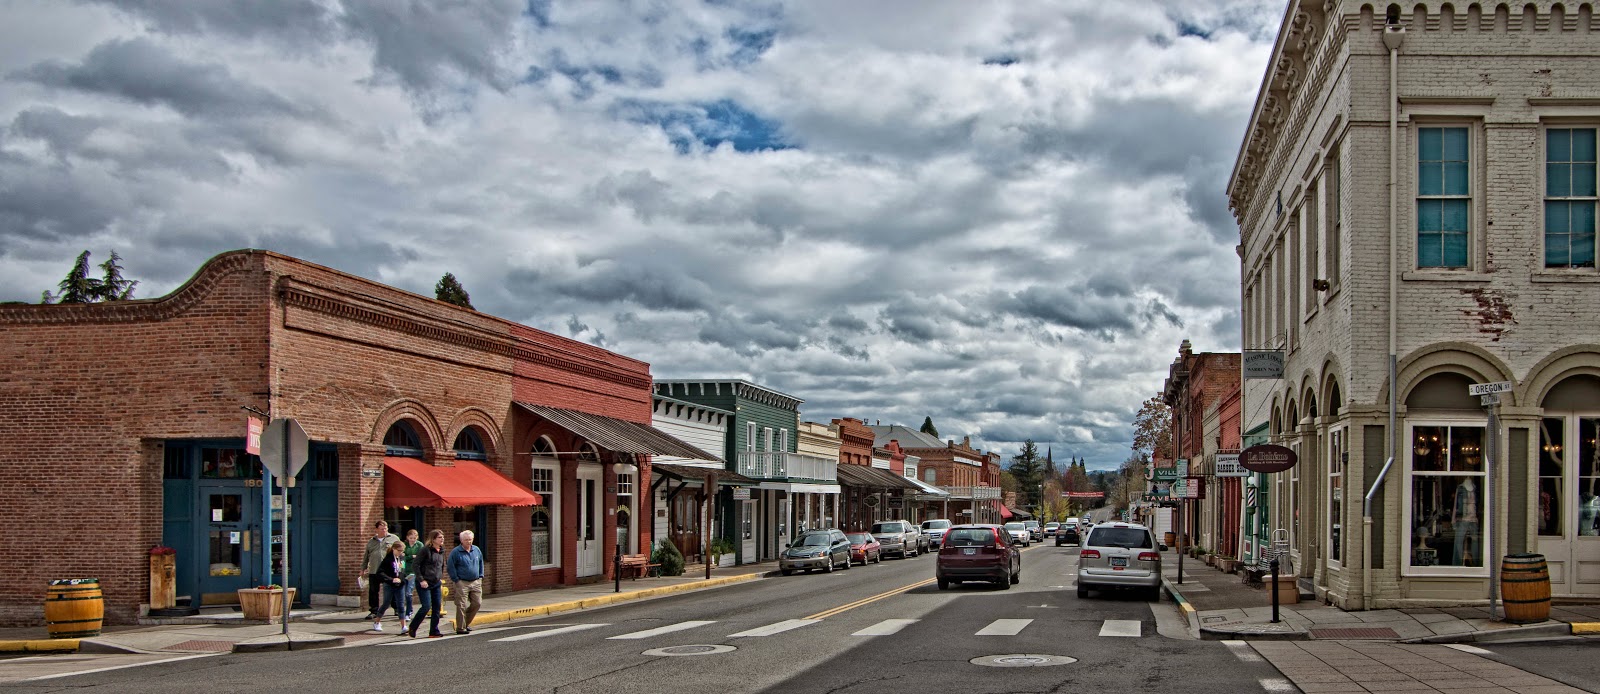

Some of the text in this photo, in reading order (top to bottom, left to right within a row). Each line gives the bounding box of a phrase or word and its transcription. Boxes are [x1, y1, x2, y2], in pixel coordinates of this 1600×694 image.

[1475, 383, 1503, 393] OREGON
[1247, 451, 1258, 461] La
[1217, 464, 1235, 473] BARBER
[244, 479, 263, 487] 180
